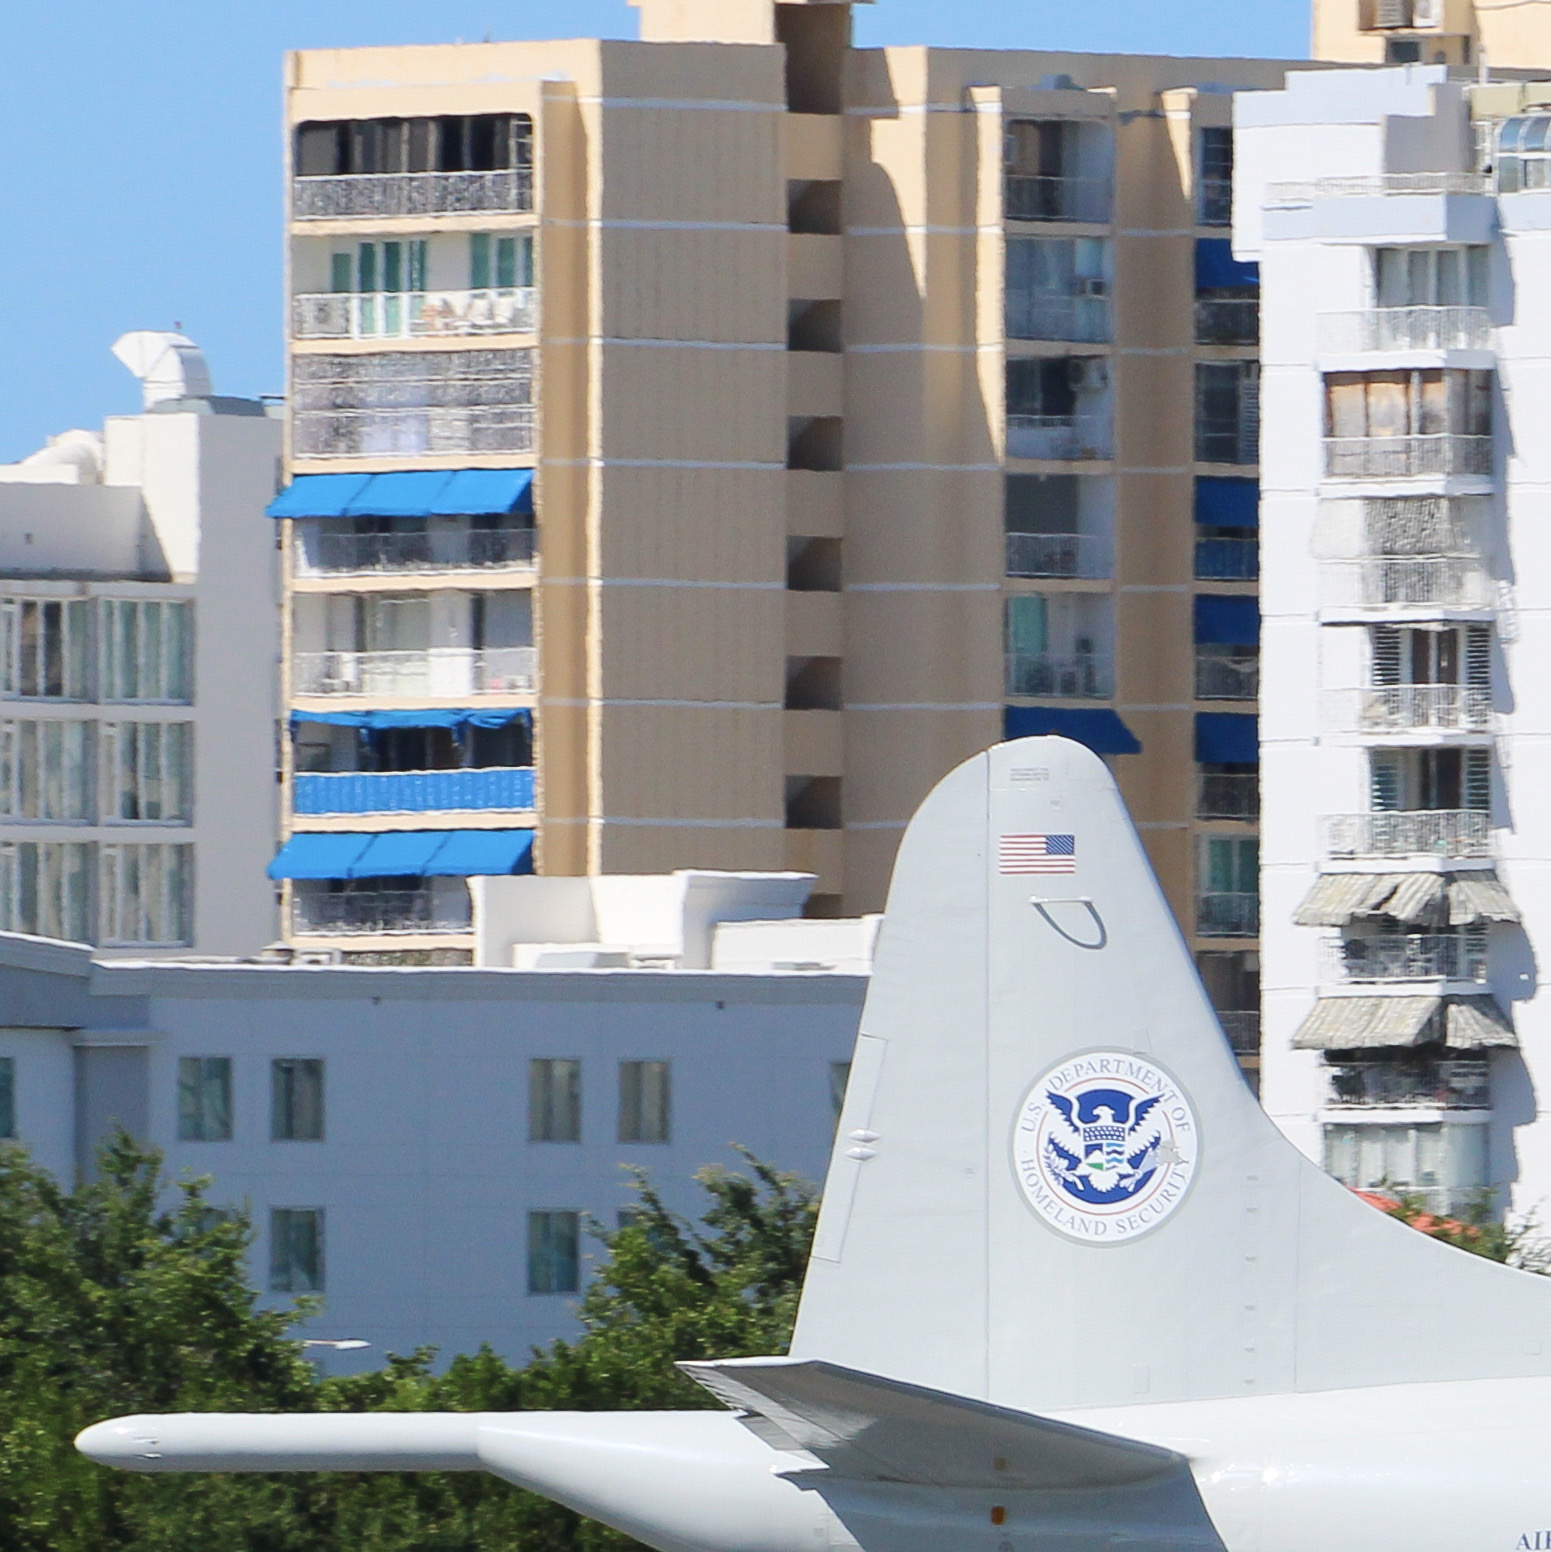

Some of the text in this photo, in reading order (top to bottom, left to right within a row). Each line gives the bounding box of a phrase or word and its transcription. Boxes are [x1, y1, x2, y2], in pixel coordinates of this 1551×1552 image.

[1021, 1058, 1192, 1132] U.S. DEPARTMENT OF
[1021, 1157, 1191, 1236] HOMELAND SECURITY
